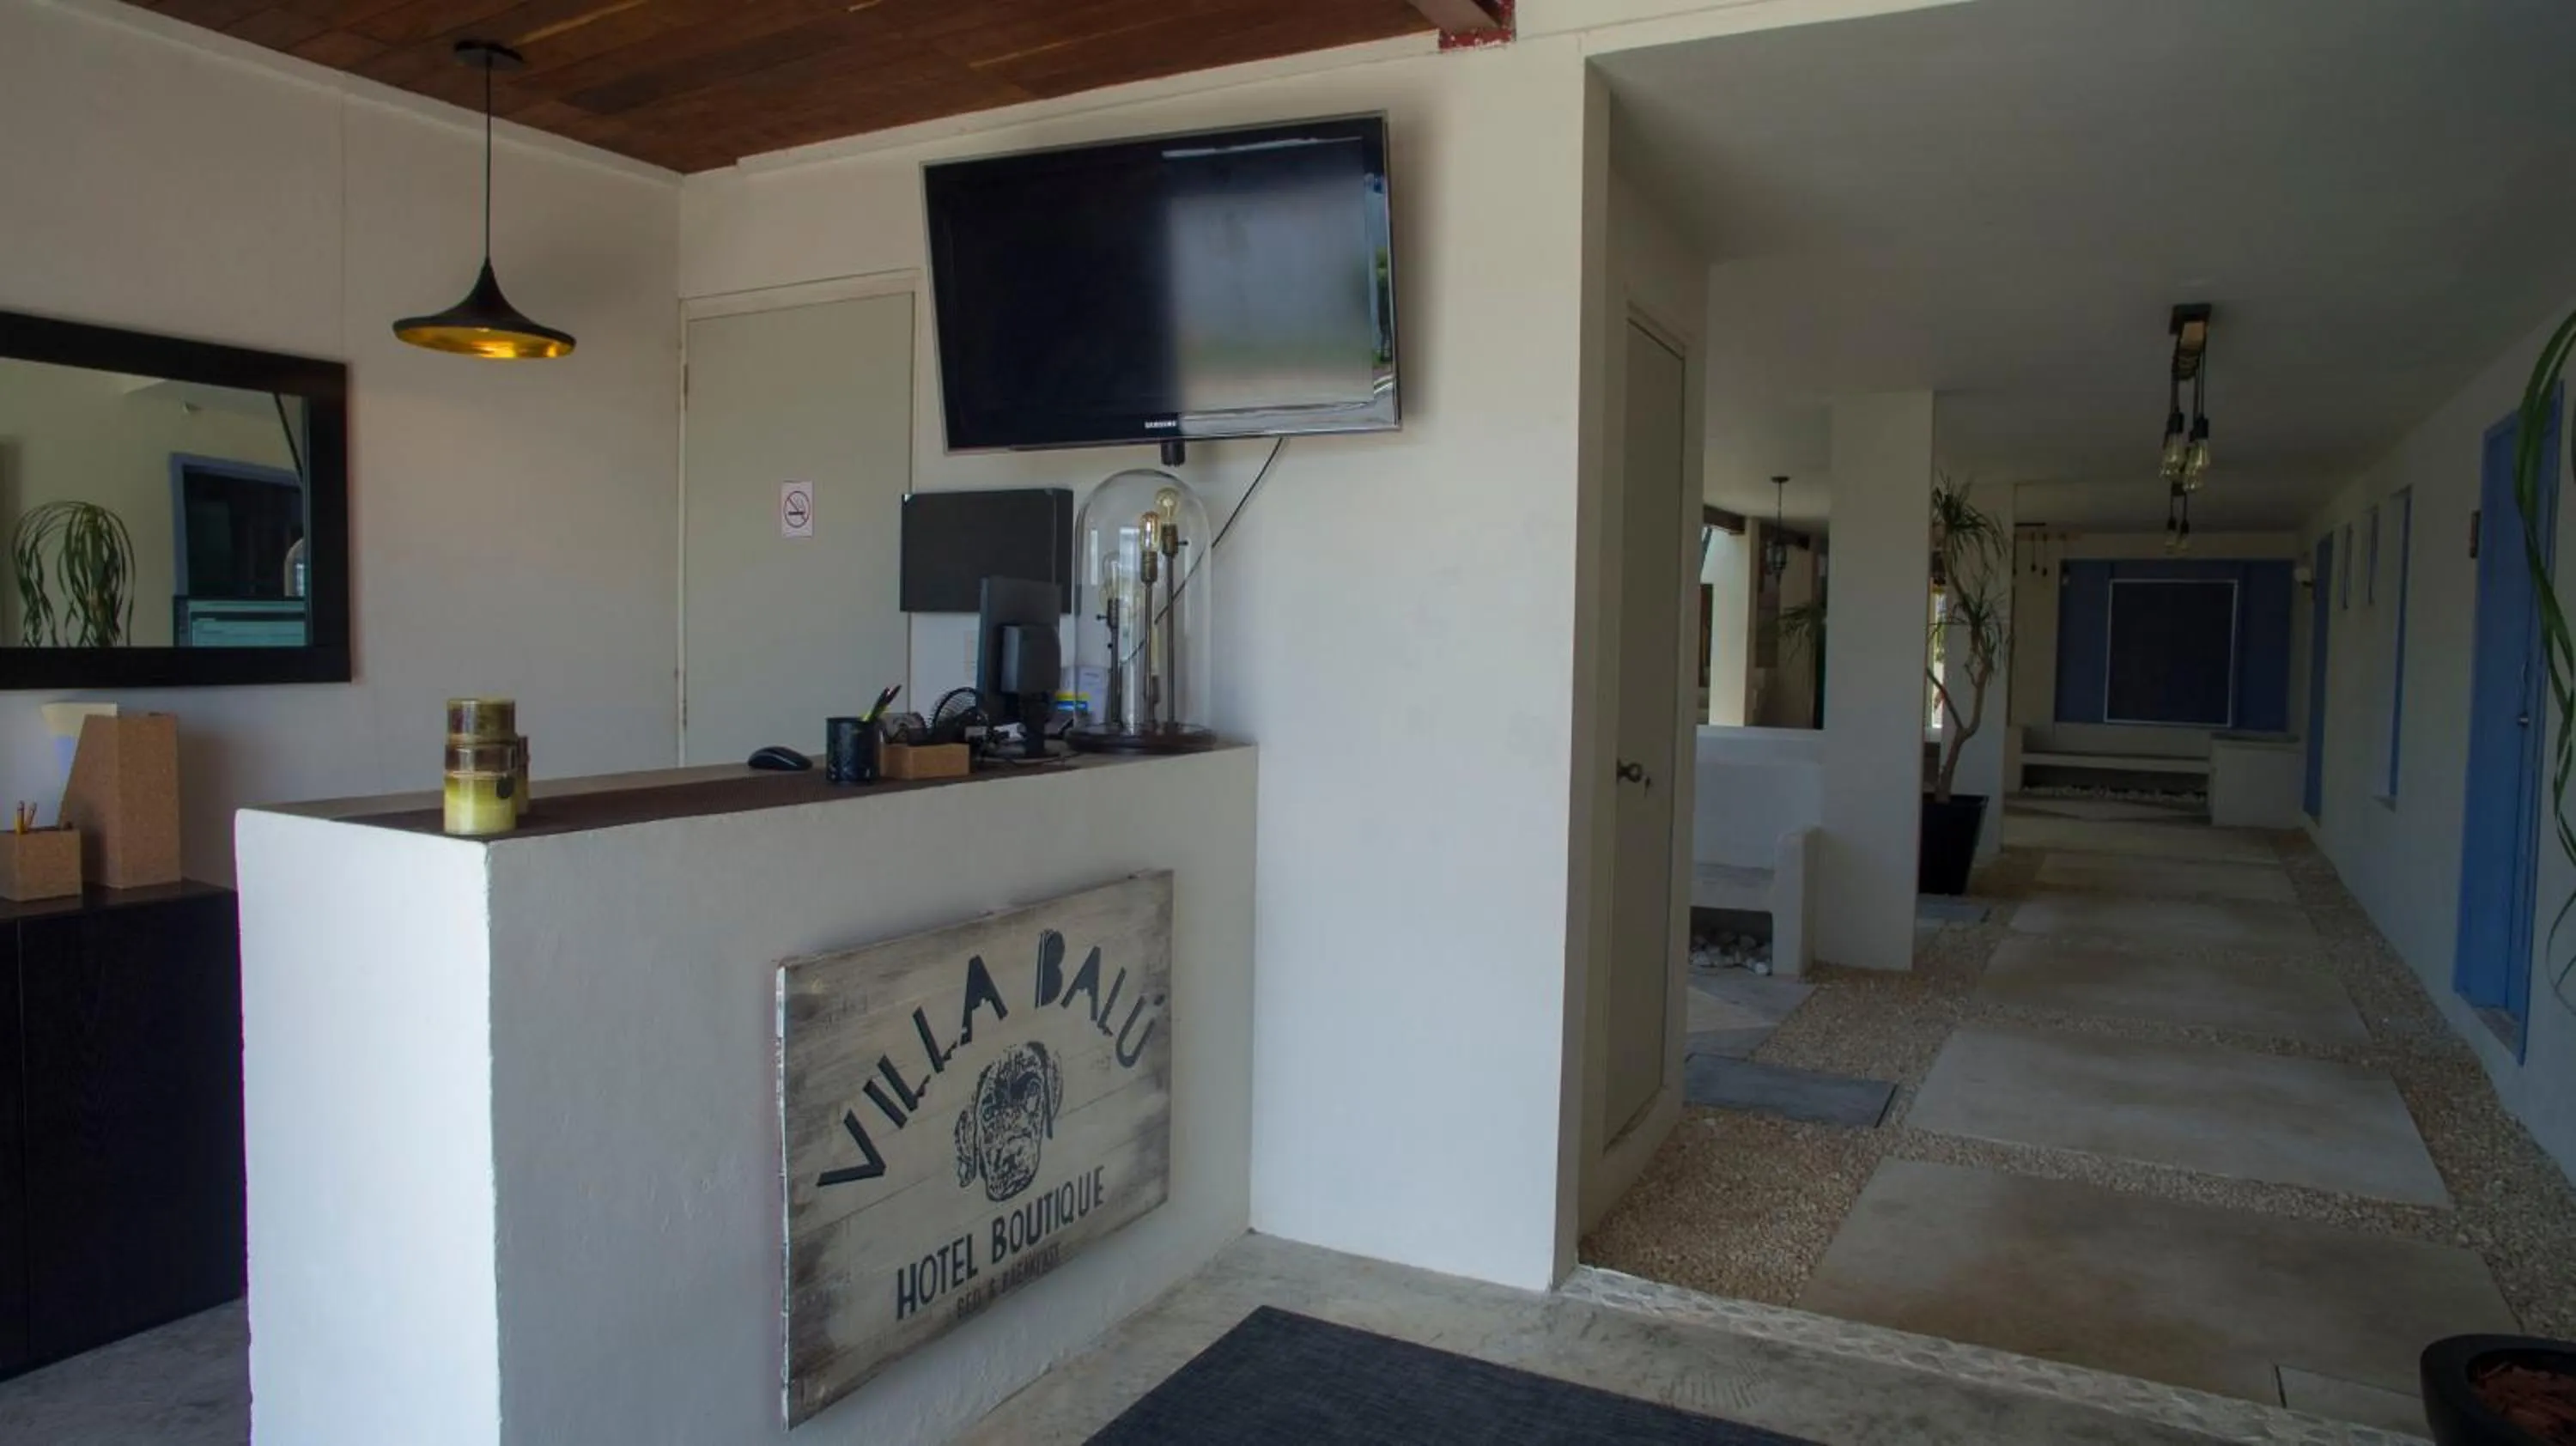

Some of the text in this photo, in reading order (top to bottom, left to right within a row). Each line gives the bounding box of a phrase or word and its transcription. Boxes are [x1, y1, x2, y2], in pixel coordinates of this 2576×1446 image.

[817, 954, 1008, 1187] VILLA
[896, 1165, 1104, 1321] HOTEL BOUTIQUE
